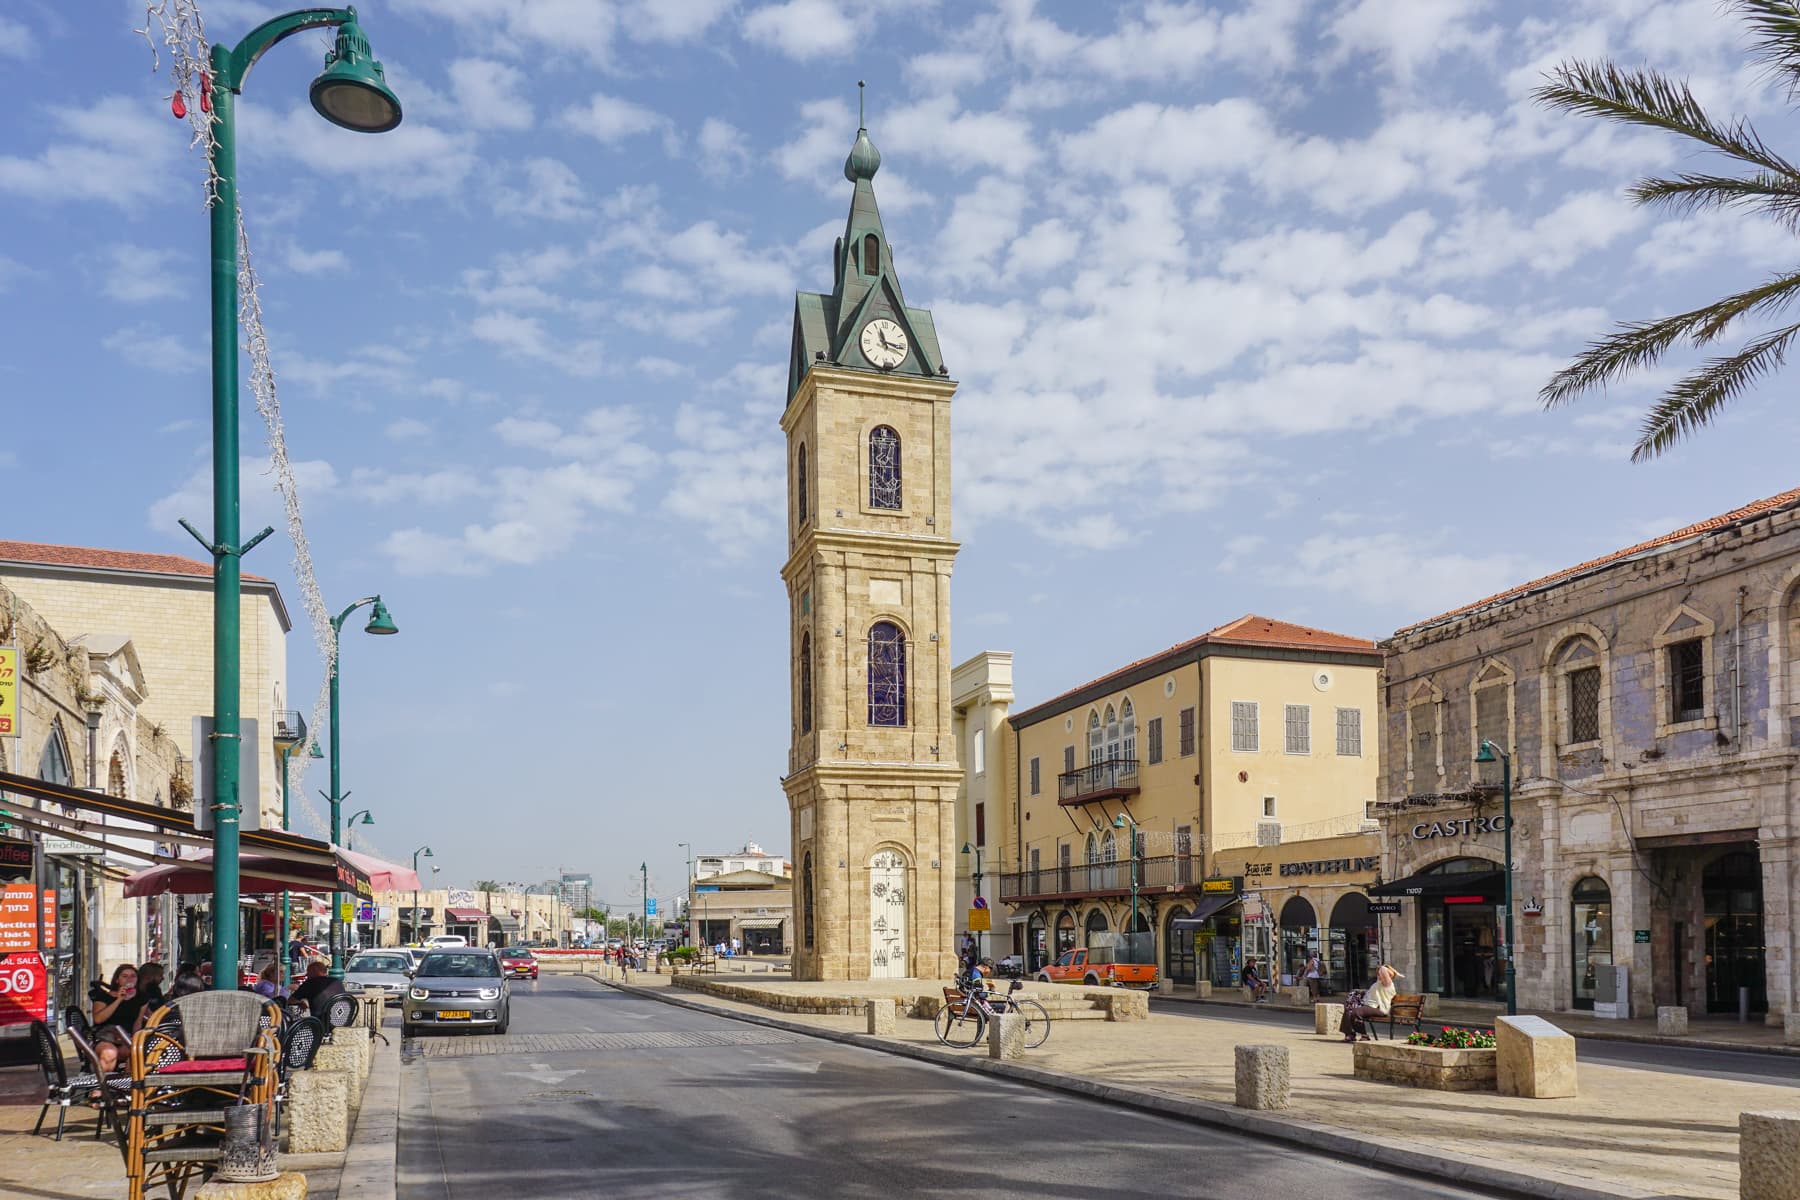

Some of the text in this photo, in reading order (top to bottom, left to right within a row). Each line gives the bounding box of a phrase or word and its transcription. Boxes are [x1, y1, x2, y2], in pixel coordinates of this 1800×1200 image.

[1412, 815, 1511, 839] CASTRO
[1279, 856, 1381, 877] BOARDERLINE
[1202, 880, 1233, 892] CHANGE
[4, 930, 31, 938] back
